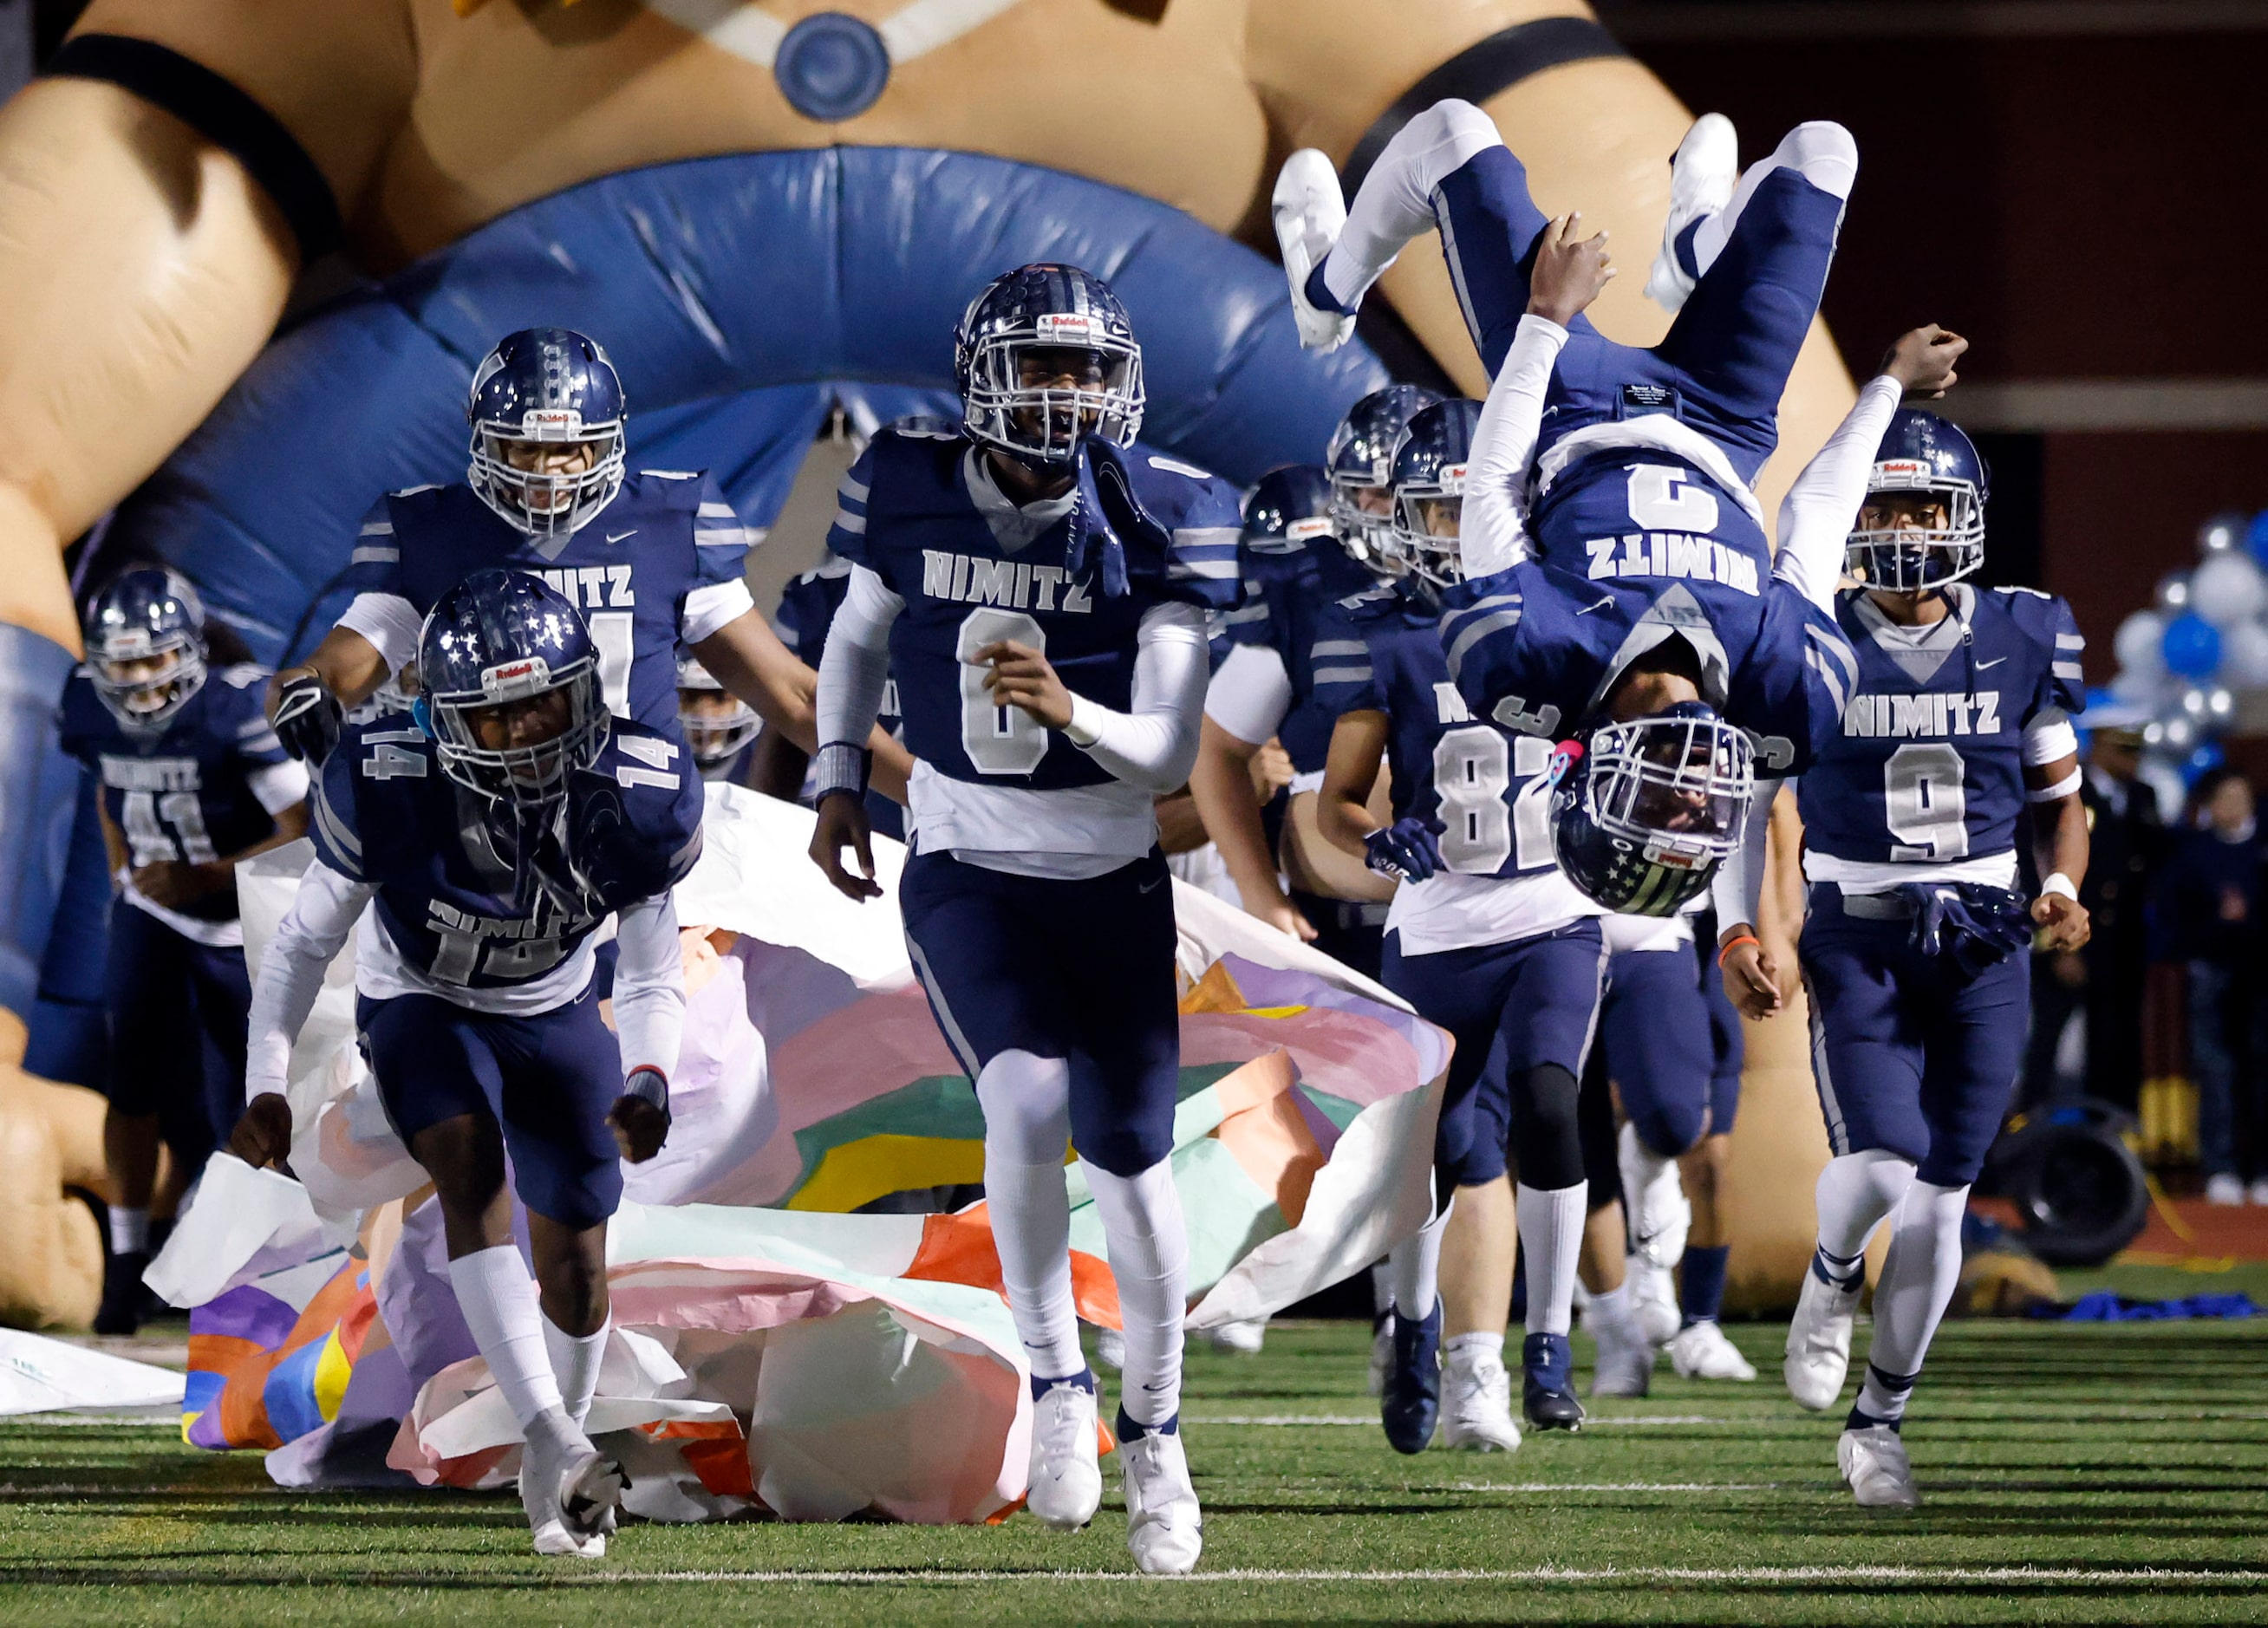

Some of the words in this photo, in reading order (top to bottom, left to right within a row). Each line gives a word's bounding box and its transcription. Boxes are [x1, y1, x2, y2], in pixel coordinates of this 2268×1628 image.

[1052, 316, 1089, 328] Riddell
[537, 414, 569, 423] Riddell
[524, 564, 635, 609] ITZ
[922, 549, 1094, 614] NIMITZ
[1586, 533, 1761, 597] NIMITZ
[495, 662, 532, 681] Riddell
[1844, 690, 2001, 739] NIMITZ
[361, 726, 427, 781] 14
[616, 733, 681, 791] 14
[1432, 725, 1558, 875] 82
[1884, 742, 1969, 863] 9
